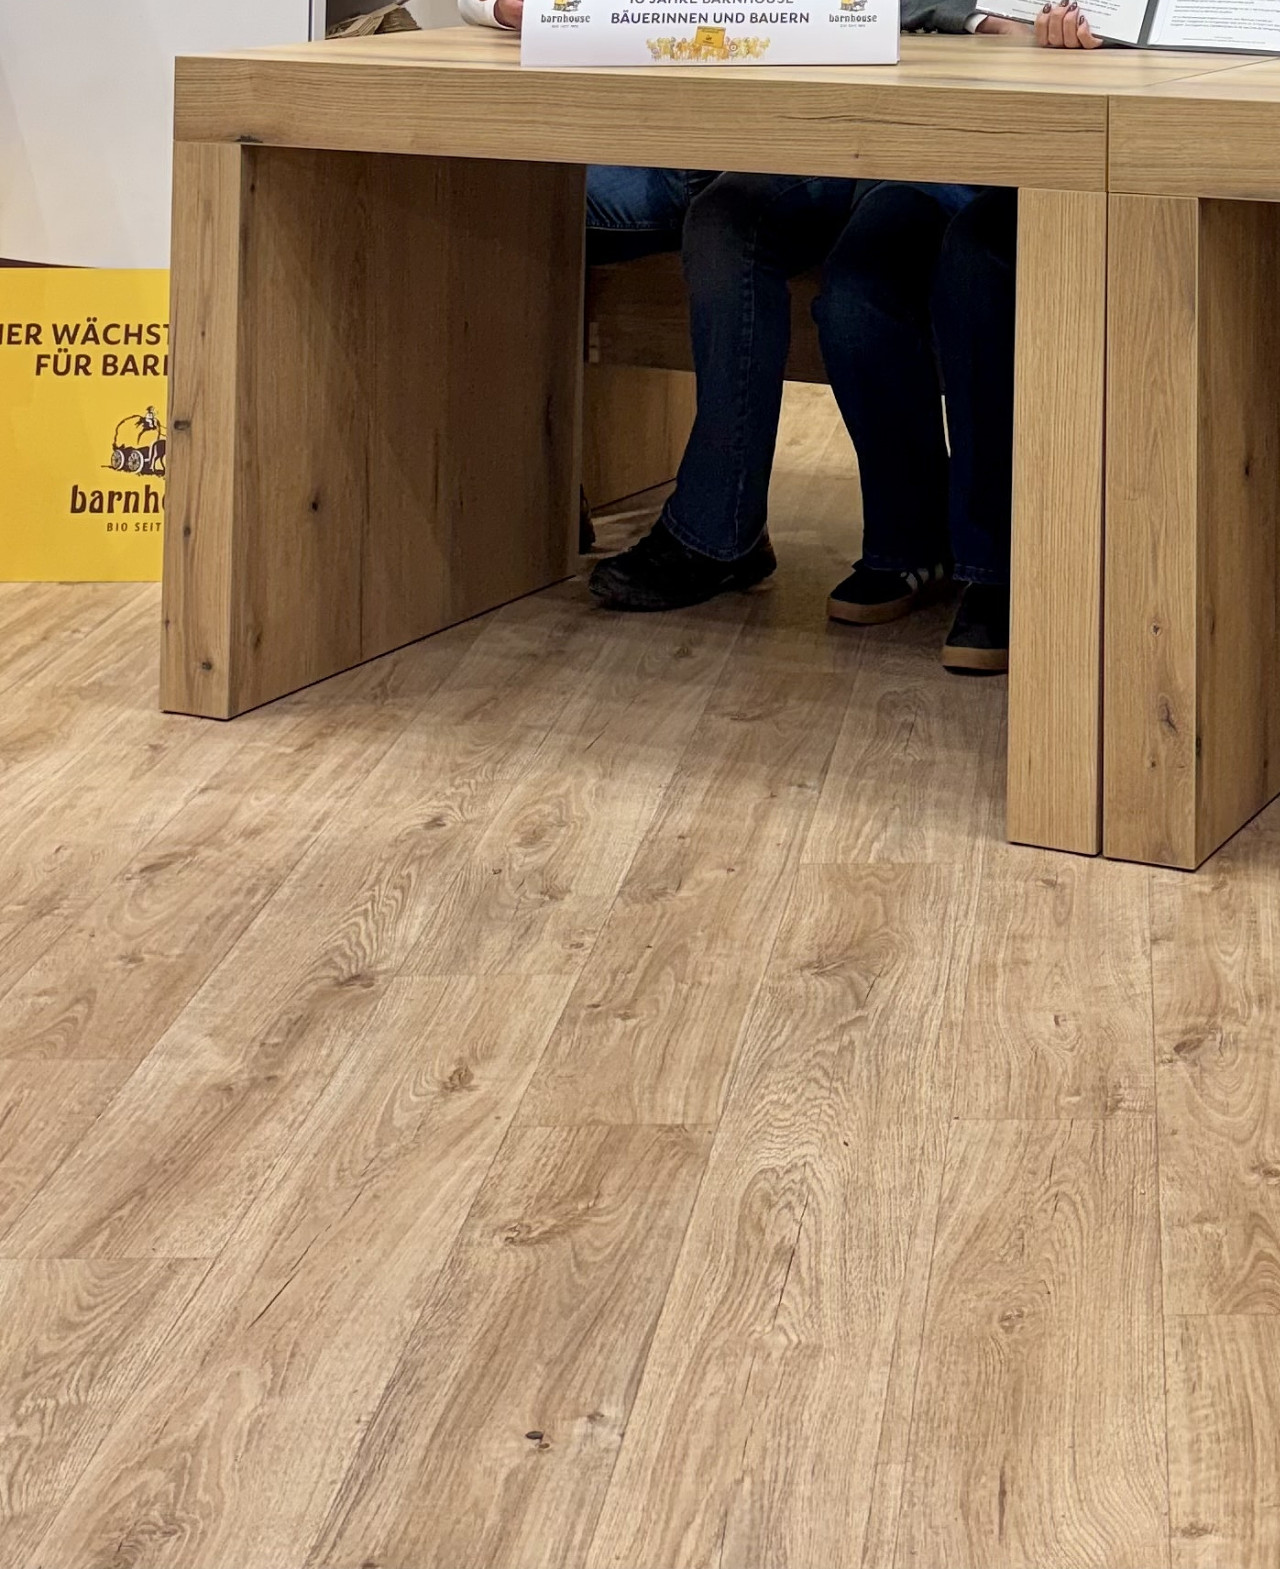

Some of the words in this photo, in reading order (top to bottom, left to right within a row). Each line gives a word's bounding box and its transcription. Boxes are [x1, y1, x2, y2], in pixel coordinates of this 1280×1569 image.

[541, 13, 590, 23] barnhouse
[611, 10, 708, 24] BÄUERINNEN
[713, 12, 745, 24] UND
[749, 12, 810, 24] BAUERN
[829, 13, 877, 23] barnhouse
[35, 348, 93, 376] FÜR
[102, 354, 168, 376] BAR
[70, 484, 164, 513] barnh
[107, 522, 128, 532] BIO
[135, 522, 161, 532] SEIT
